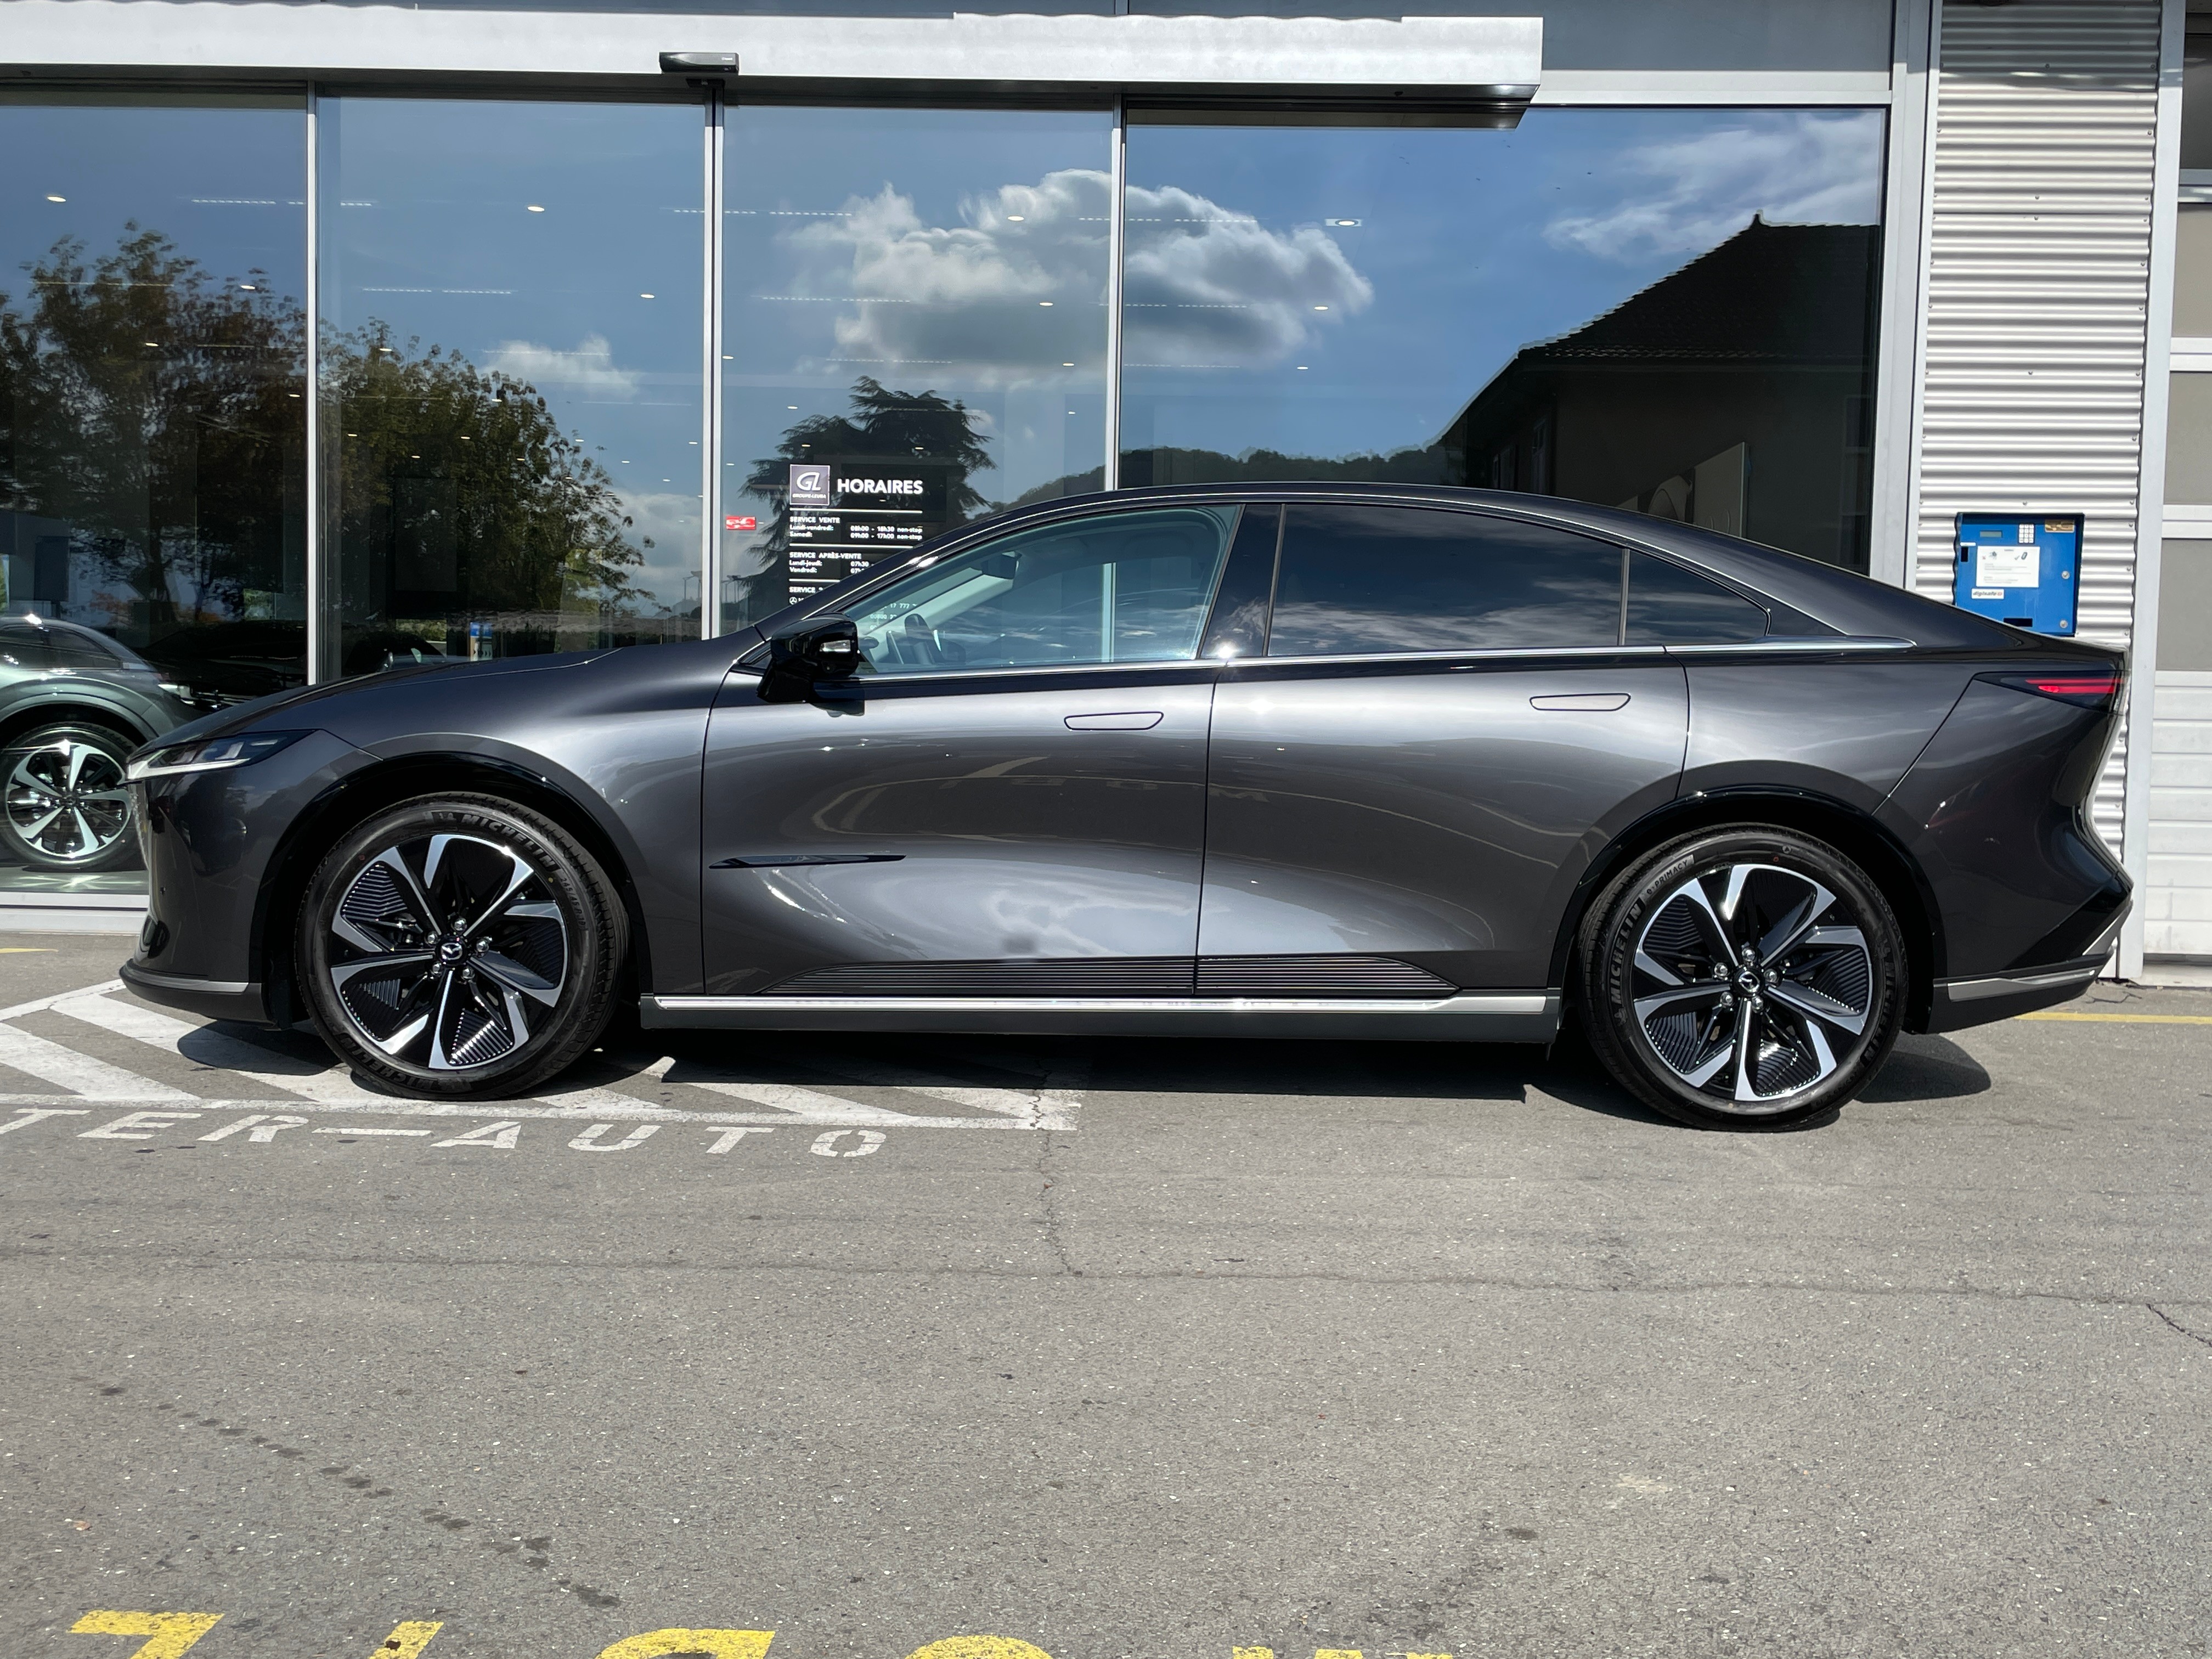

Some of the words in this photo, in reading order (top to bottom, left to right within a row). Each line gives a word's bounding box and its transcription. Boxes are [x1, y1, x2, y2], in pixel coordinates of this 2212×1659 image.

[797, 472, 821, 491] GL
[837, 478, 923, 494] HORAIRES
[461, 814, 557, 871] MICHELIN
[1611, 902, 1643, 1005] MICHELIN
